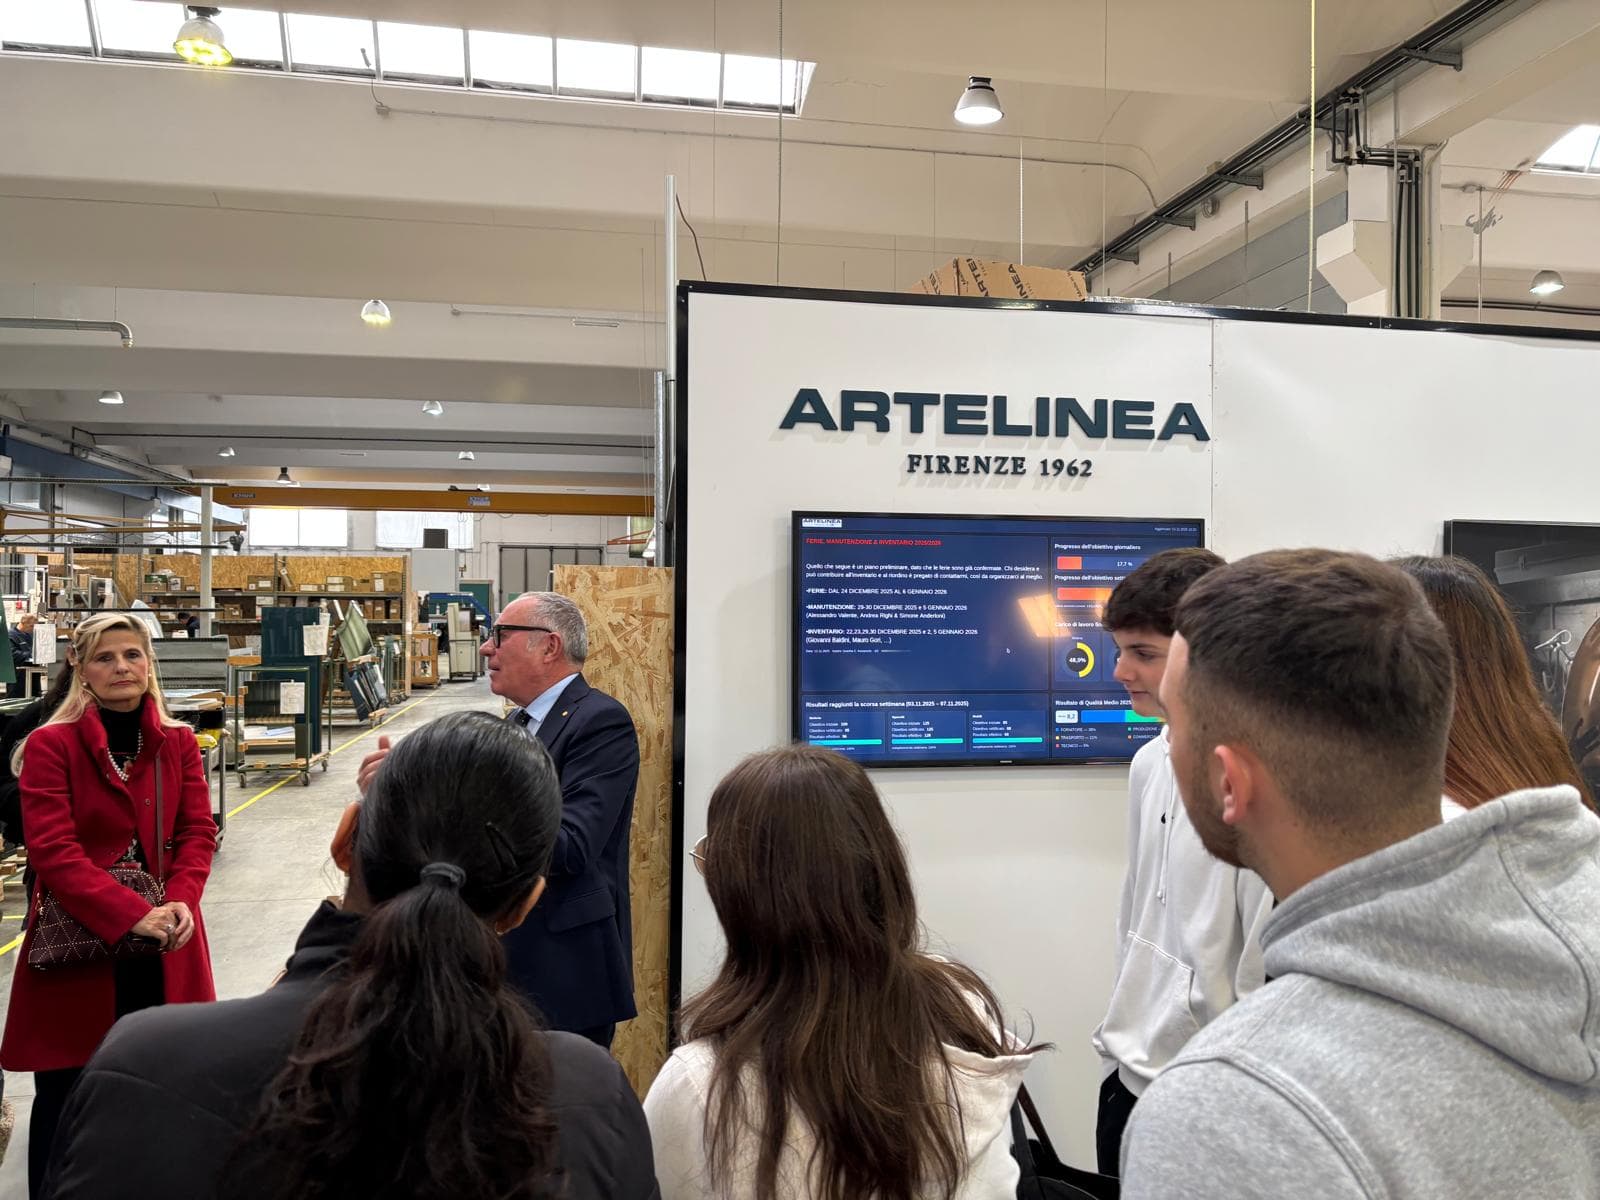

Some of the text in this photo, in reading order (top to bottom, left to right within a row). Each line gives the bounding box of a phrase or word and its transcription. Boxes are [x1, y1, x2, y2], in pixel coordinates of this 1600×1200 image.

[778, 388, 1210, 441] ARTELINEA
[907, 454, 1093, 478] FIRENZE 1962
[805, 563, 823, 572] Quello
[835, 563, 851, 572] segue
[864, 564, 880, 572] piano
[965, 565, 973, 573] già
[806, 571, 816, 580] può
